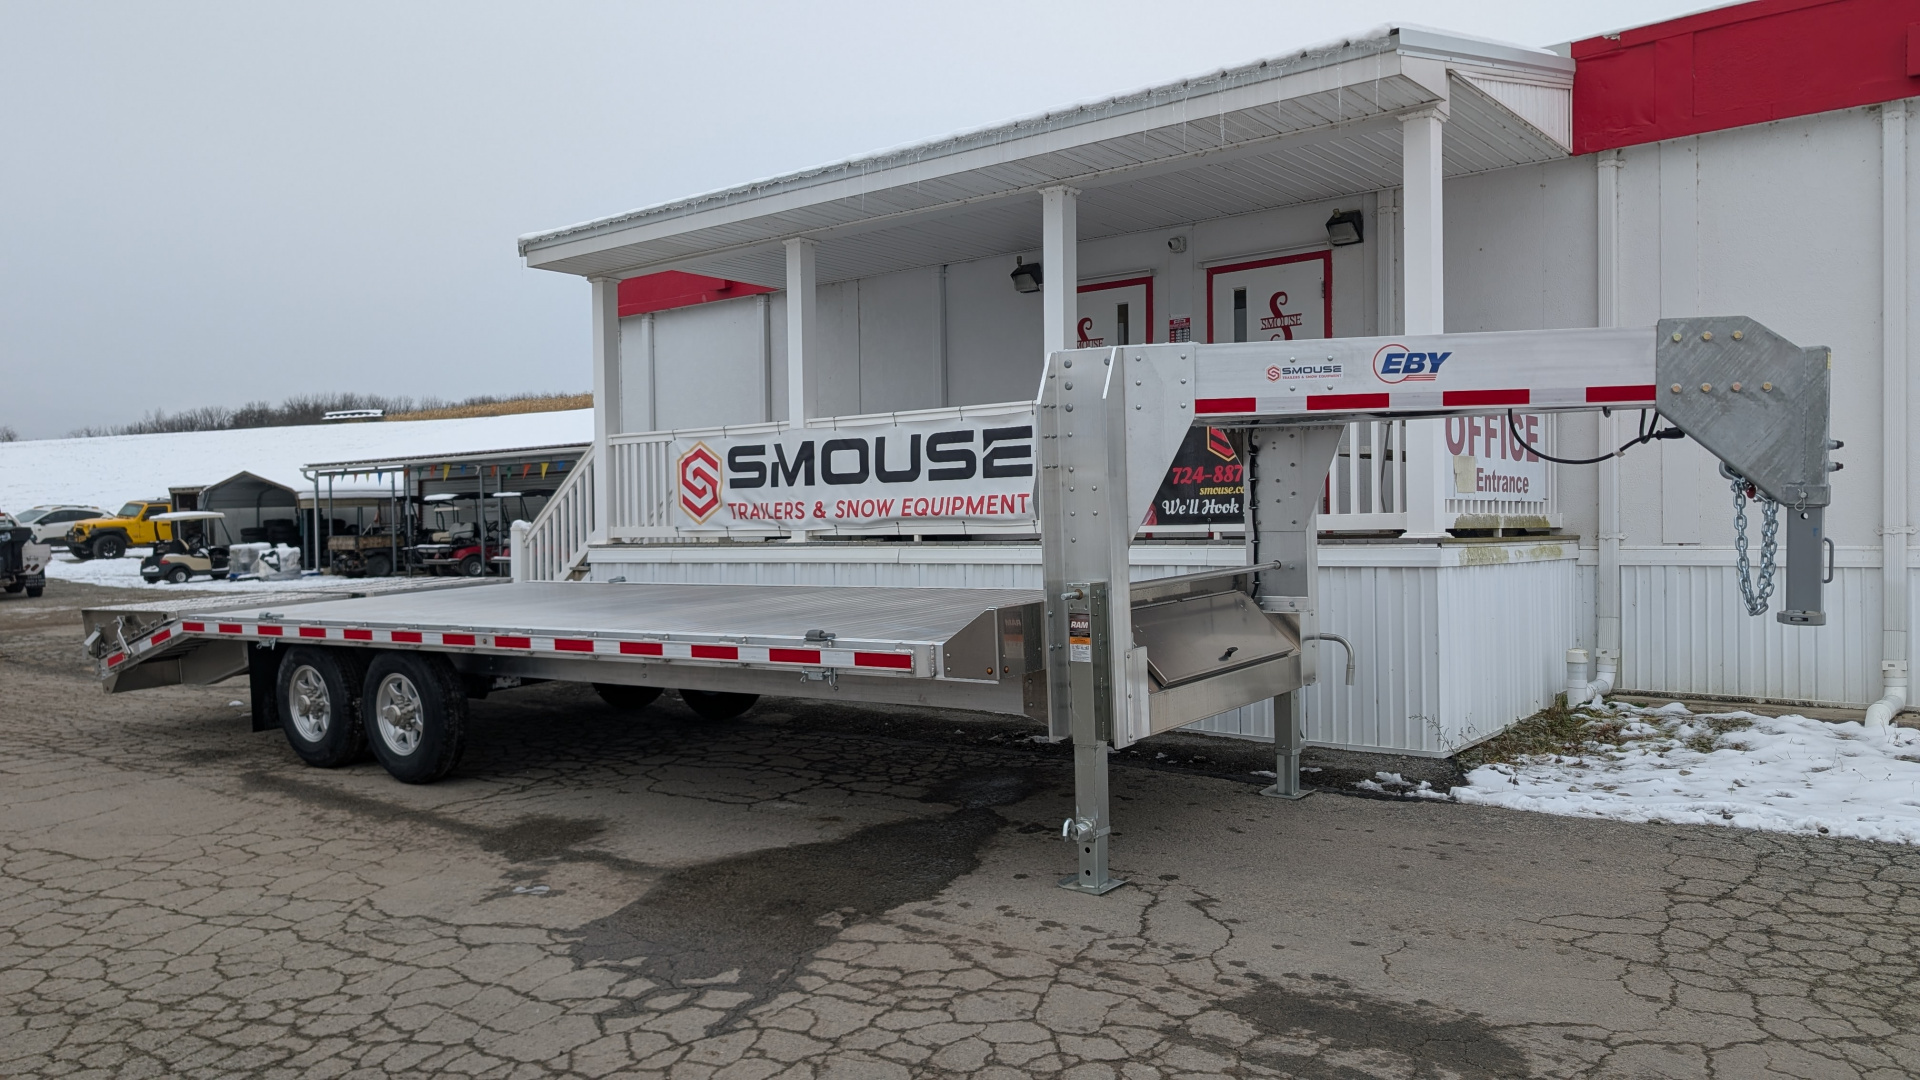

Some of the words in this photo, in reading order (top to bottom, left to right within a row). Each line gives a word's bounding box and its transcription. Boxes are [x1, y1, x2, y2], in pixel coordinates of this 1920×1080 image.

[1260, 313, 1302, 330] SMOUSE
[1281, 365, 1342, 375] SMOUSE
[1381, 351, 1453, 374] EBY
[1445, 414, 1539, 463] OFFICE
[727, 425, 1033, 489] SMOUSE
[1476, 467, 1529, 494] Entrance
[728, 501, 806, 520] TRAILERS
[813, 503, 826, 519] &
[835, 497, 897, 519] SNOW
[901, 493, 1030, 518] EQUIPMENT
[1162, 498, 1199, 515] We'll
[1201, 497, 1240, 515] Hook
[1070, 621, 1089, 629] RAM
